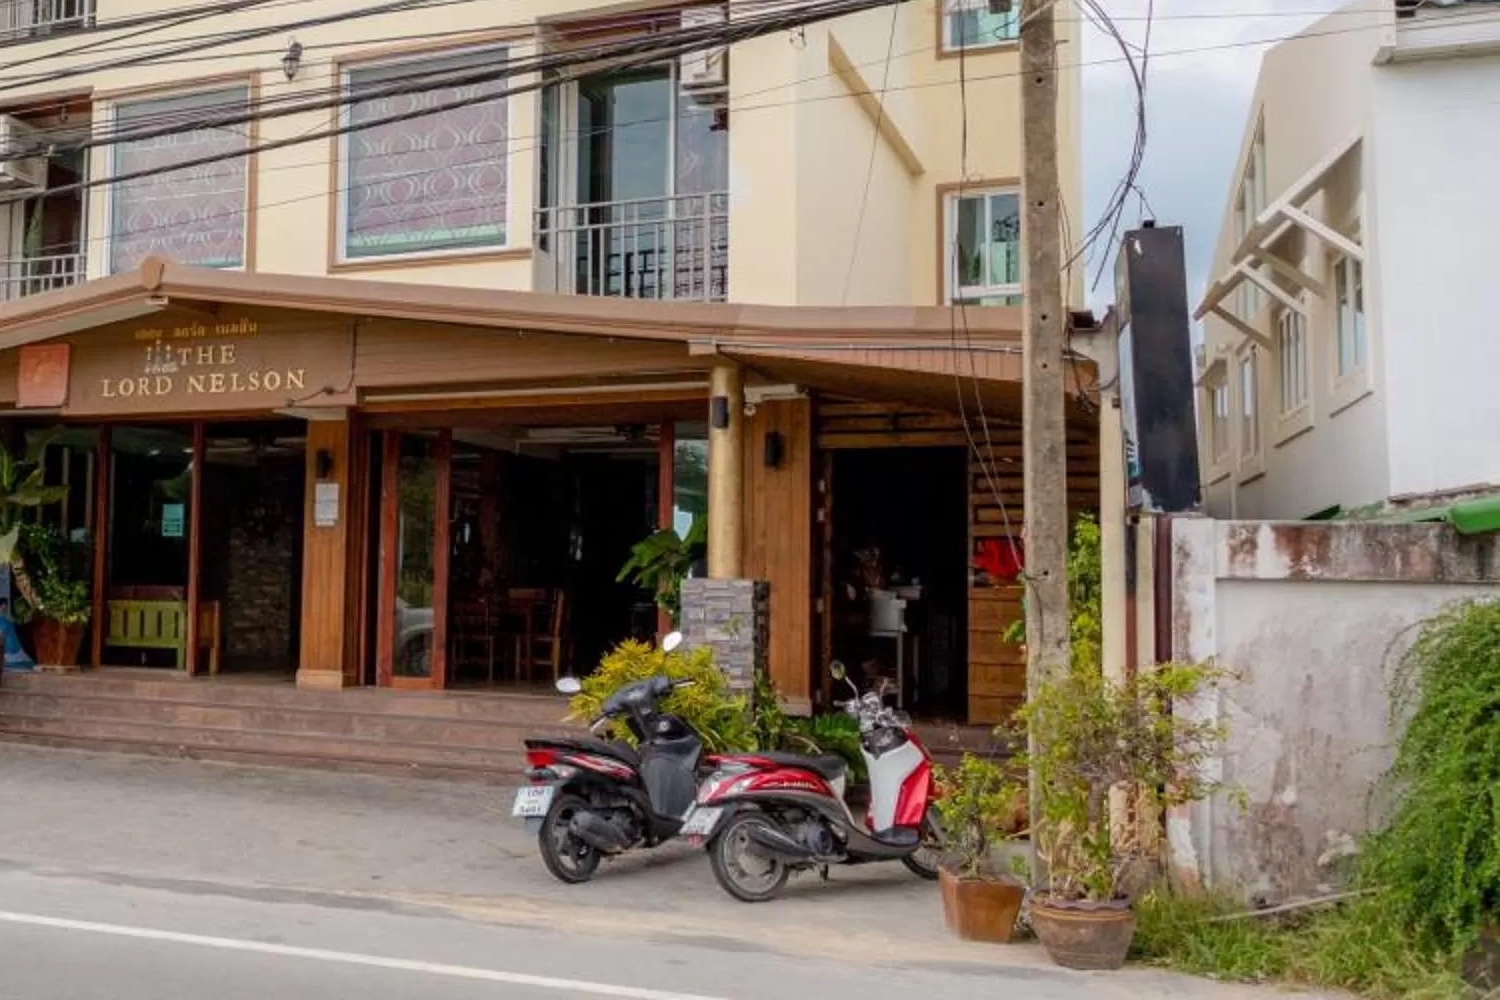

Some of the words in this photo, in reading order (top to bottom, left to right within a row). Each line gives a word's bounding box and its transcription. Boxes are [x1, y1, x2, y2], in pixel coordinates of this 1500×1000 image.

[177, 345, 237, 366] THE
[102, 376, 173, 397] LORD
[188, 369, 306, 394] NELSON
